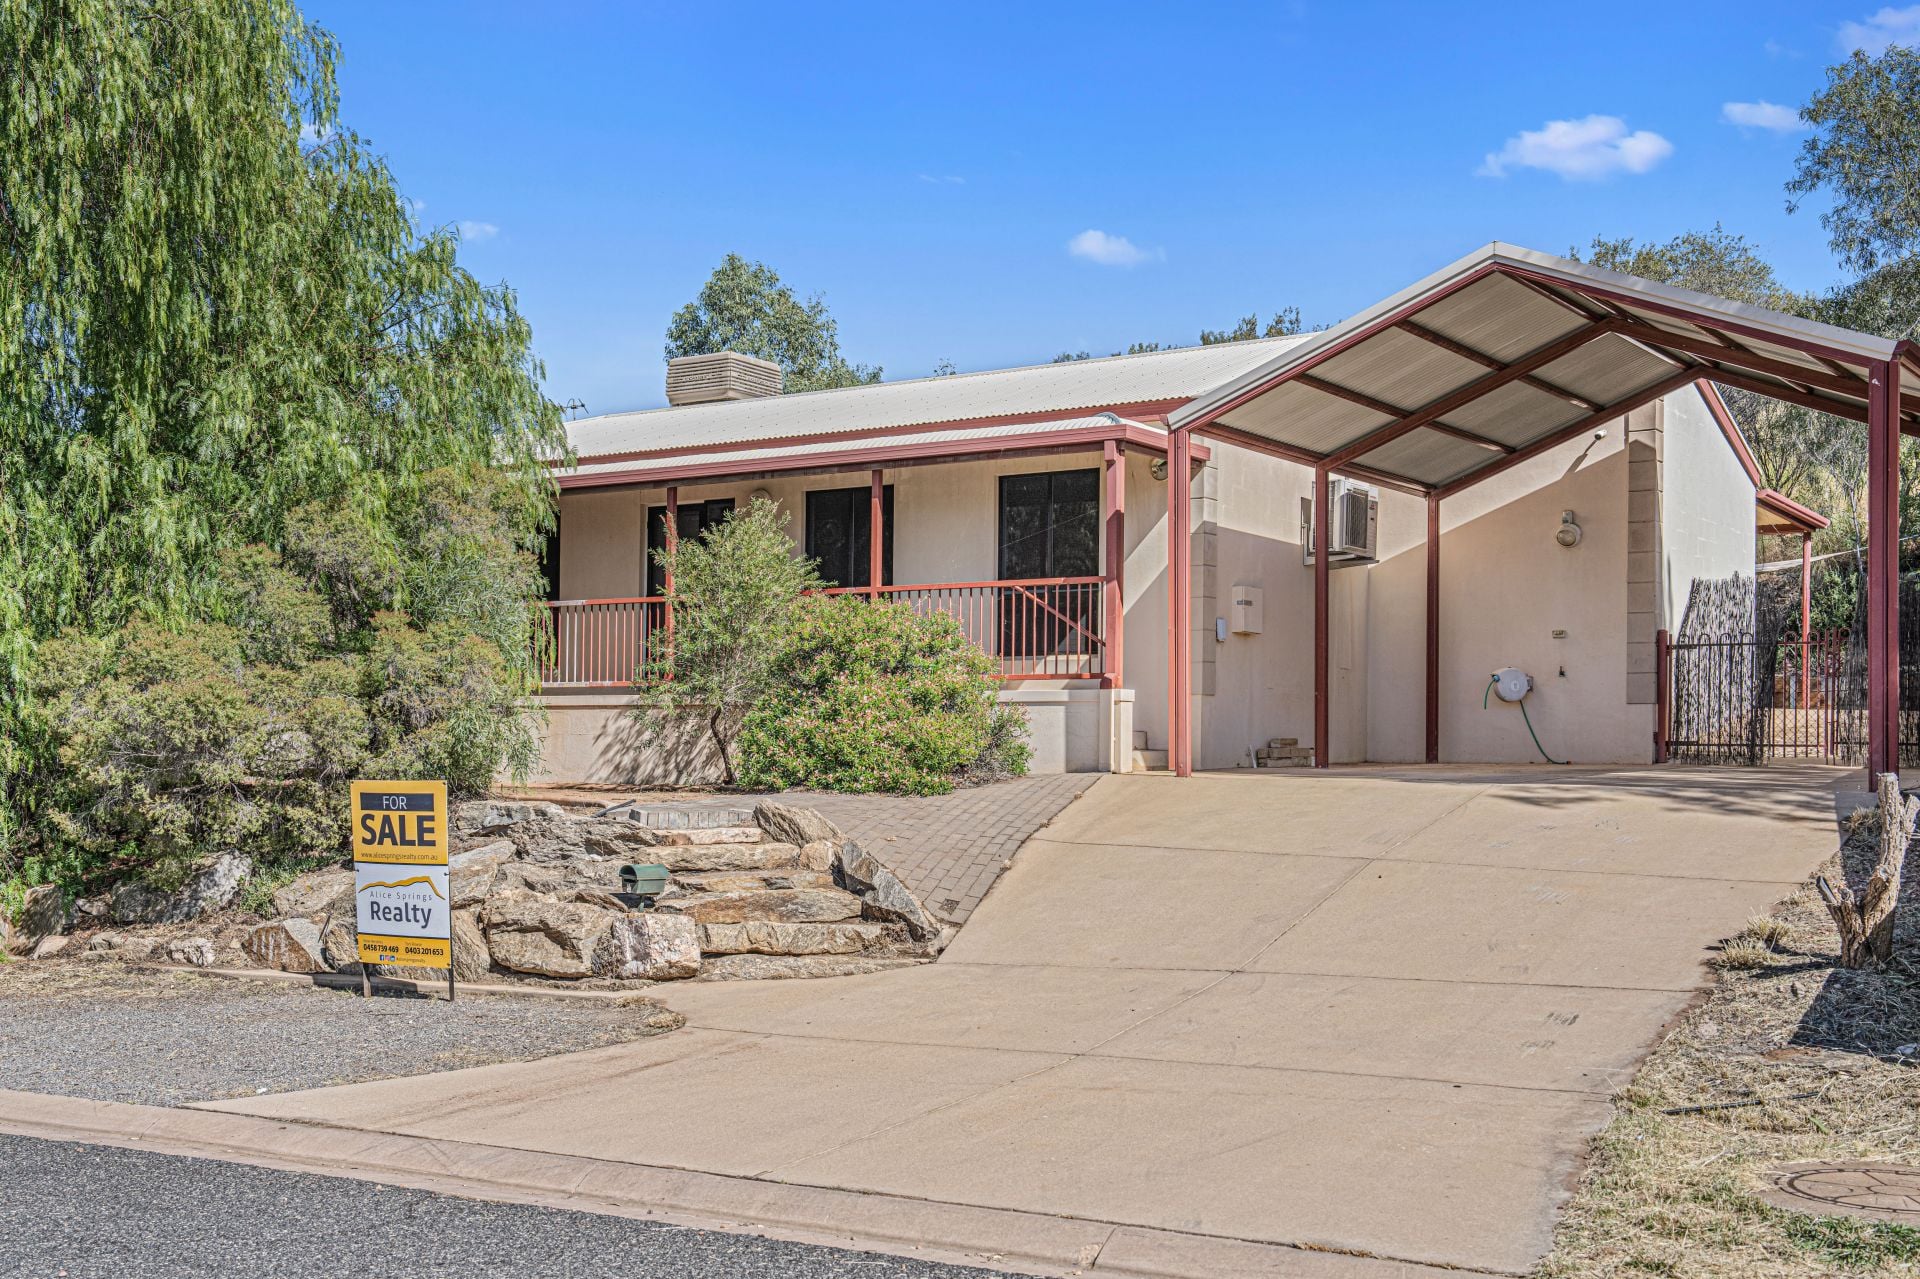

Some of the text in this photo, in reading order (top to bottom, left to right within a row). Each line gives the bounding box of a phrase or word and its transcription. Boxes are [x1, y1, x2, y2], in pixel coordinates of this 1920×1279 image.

[382, 795, 408, 810] FOR
[360, 813, 436, 847] SALE
[369, 890, 433, 903] Alice Springs
[370, 900, 432, 929] Realty
